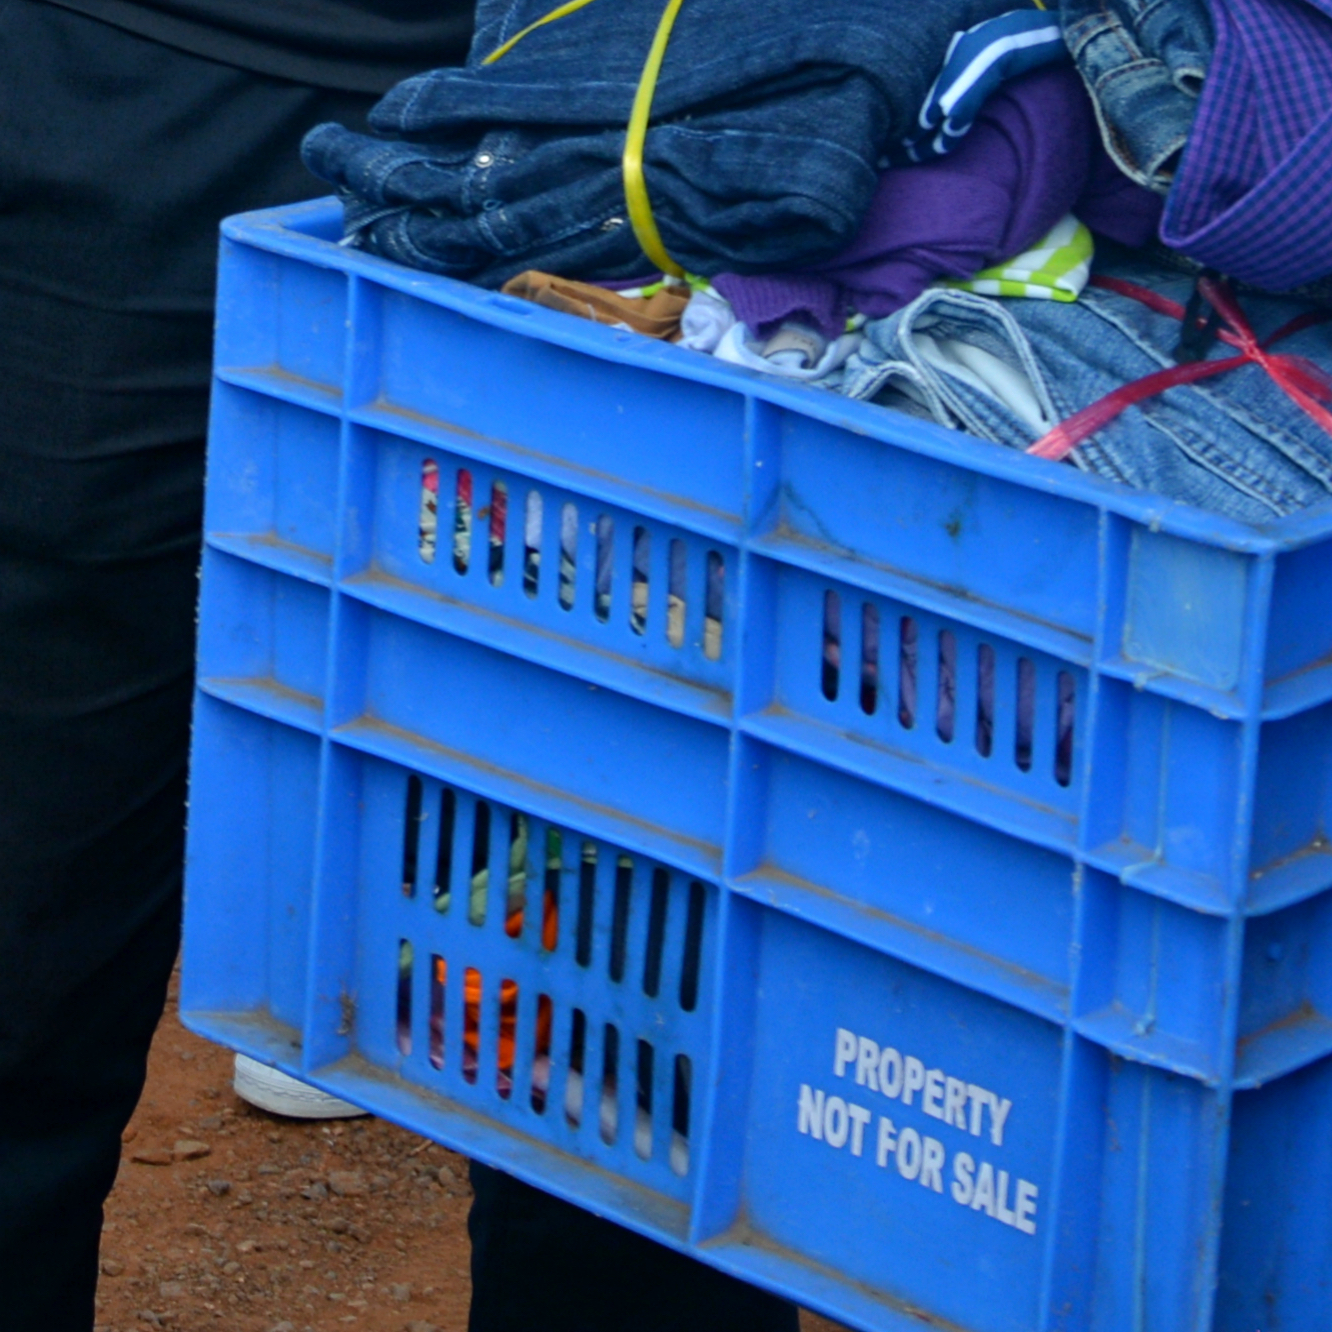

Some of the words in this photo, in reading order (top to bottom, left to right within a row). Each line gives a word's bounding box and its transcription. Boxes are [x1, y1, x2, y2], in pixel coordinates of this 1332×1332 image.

[833, 1027, 1012, 1147] PROPERTY
[797, 1083, 872, 1158] NOT
[876, 1116, 946, 1194] FOR
[951, 1151, 1038, 1235] SALE
